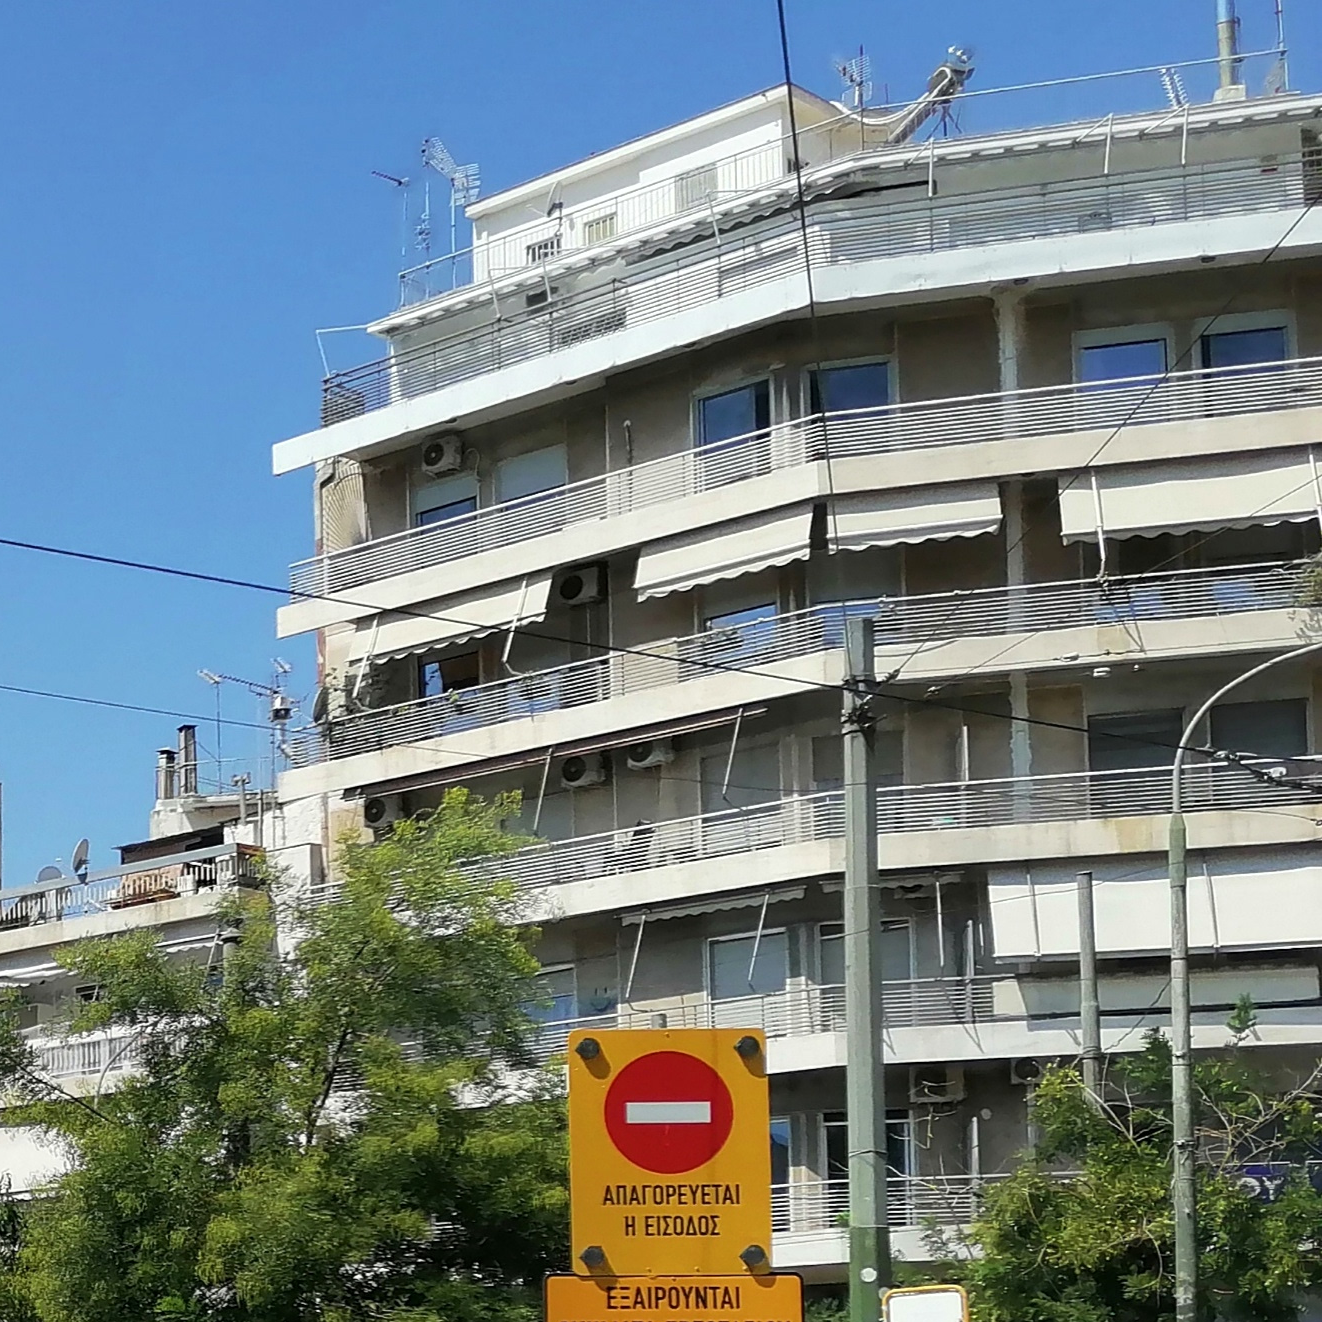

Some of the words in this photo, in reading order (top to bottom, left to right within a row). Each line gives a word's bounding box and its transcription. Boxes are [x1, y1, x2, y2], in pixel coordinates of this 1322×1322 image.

[602, 1183, 741, 1206] ΑΠΑΓΟΡΕΥΕΤΑΙ
[624, 1215, 636, 1236] Η
[644, 1214, 721, 1236] ΕΙΣΟΔΟΣ
[606, 1286, 741, 1309] ΕΞΑΙΡΟΥΝΤΑΙ
